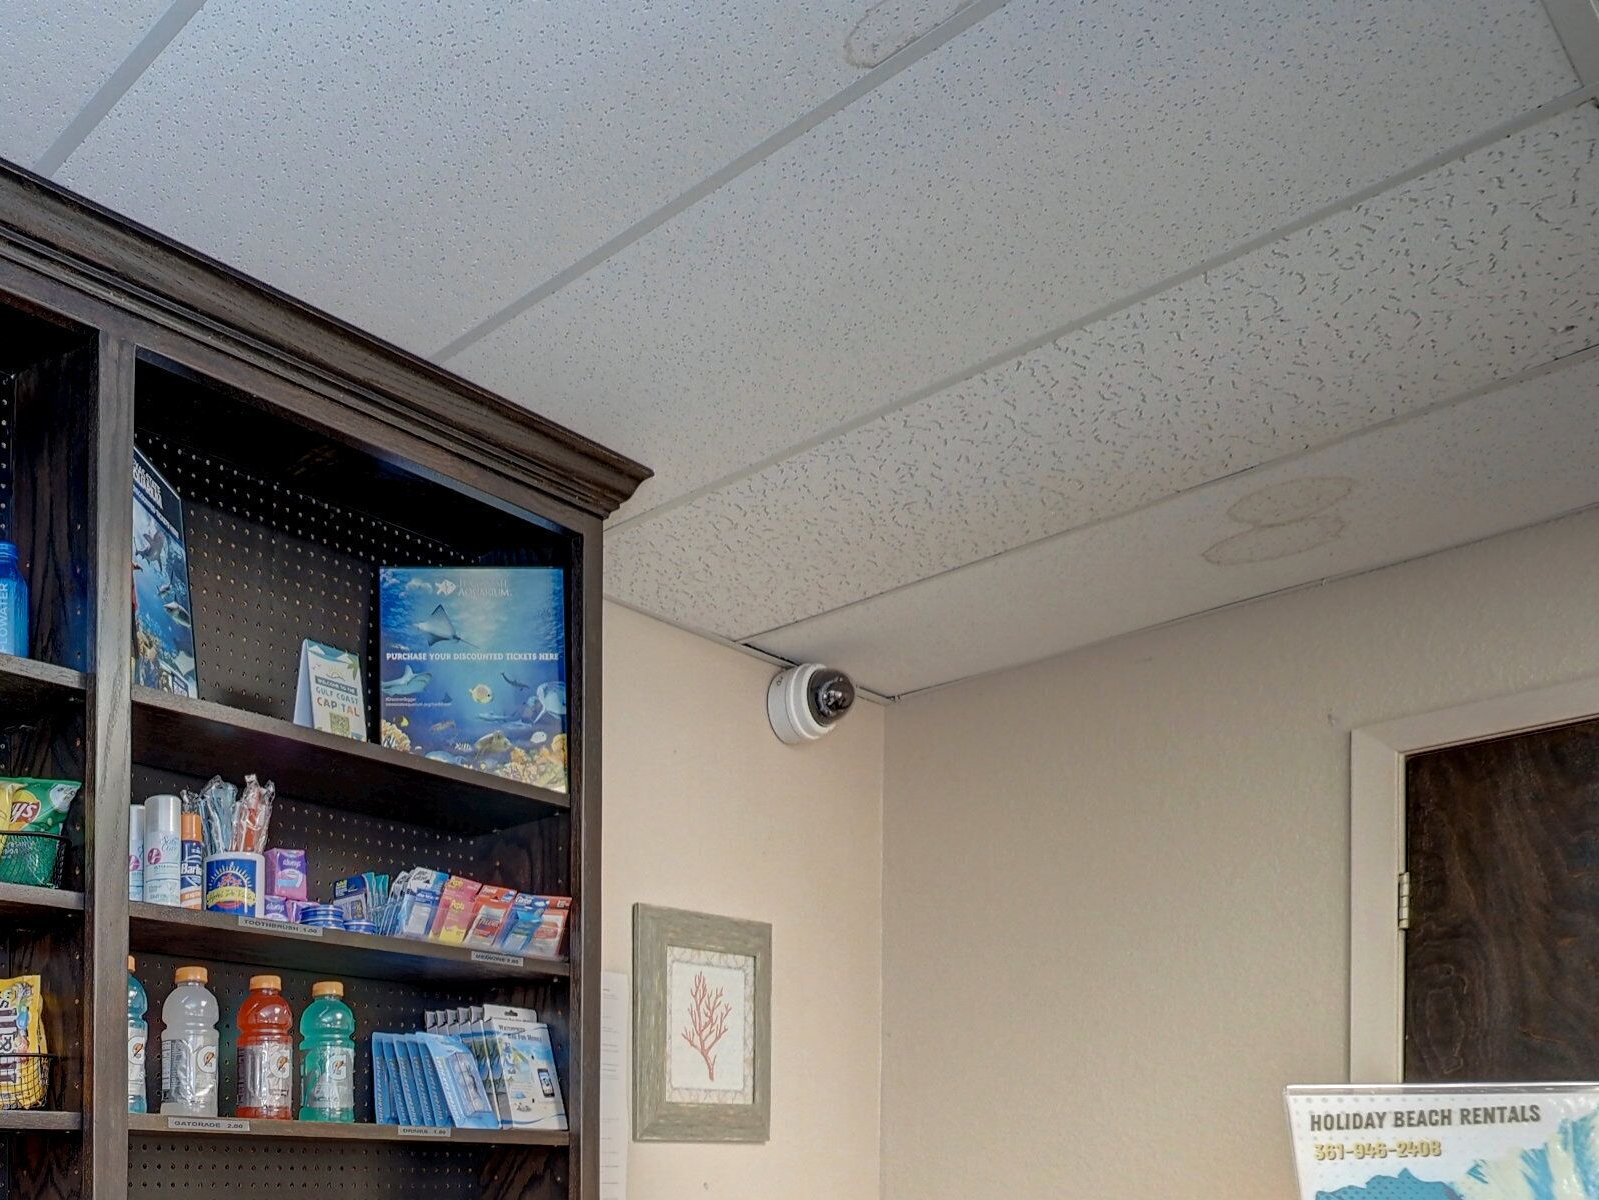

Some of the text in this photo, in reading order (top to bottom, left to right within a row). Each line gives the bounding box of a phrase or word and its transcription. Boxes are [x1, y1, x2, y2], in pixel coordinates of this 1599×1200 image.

[386, 652, 559, 661] PURCHASE YOUR DISCOUNTED TICKETS HERE
[315, 687, 359, 705] GULF COAST
[244, 919, 299, 932] TOOTHBRUSH
[174, 1120, 221, 1129] GATORADE
[1310, 1104, 1541, 1131] HOLIDAY BEACH RENTALS
[1313, 1140, 1442, 1161] 361-946-2408
